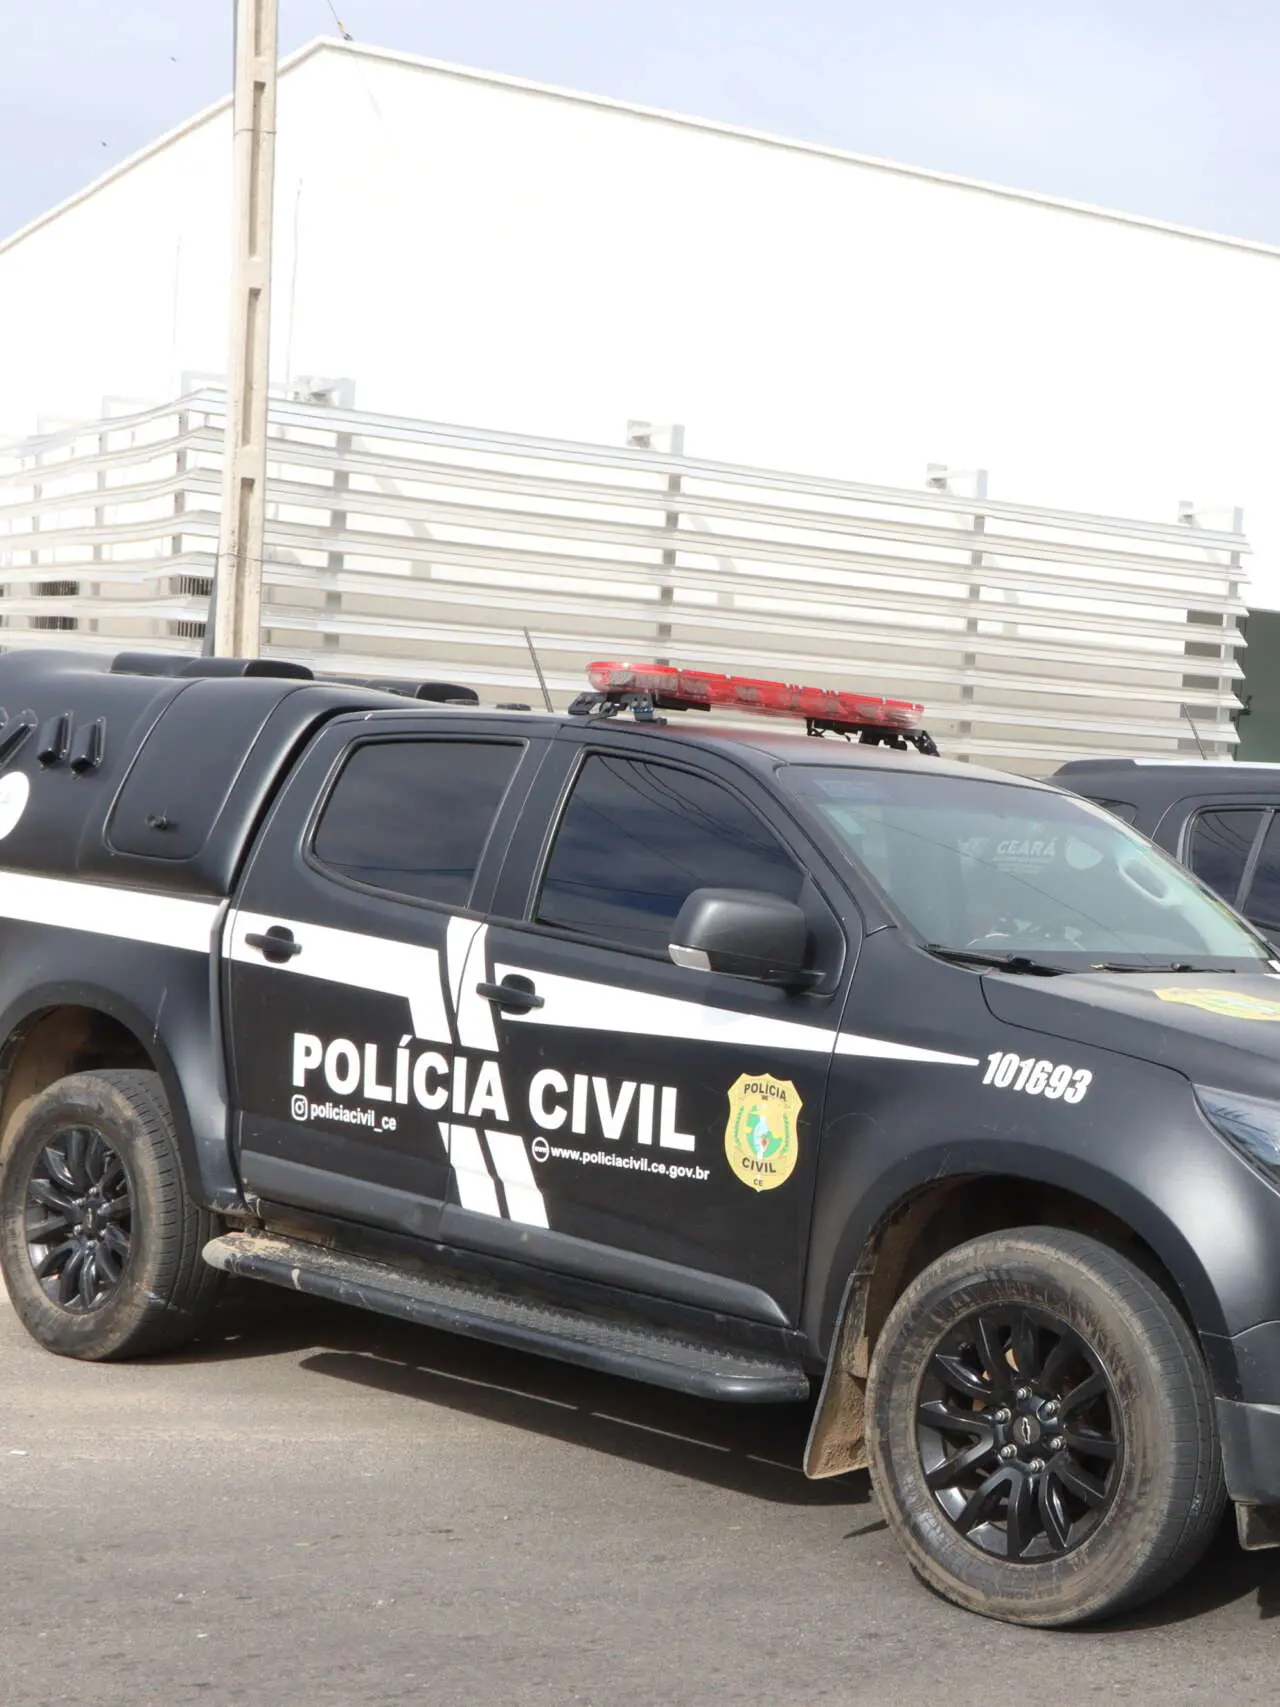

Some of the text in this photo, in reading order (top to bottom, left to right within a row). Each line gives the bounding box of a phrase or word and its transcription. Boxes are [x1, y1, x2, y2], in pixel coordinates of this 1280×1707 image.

[292, 1032, 696, 1152] POLÍCIA CIVIL
[744, 1082, 787, 1102] POLÍCIA
[982, 1051, 1093, 1104] 101693
[310, 1101, 397, 1133] policiacivil_ce
[551, 1146, 710, 1180] www.policiacivil.ce.gov.br
[742, 1157, 777, 1173] CIVIL
[753, 1178, 763, 1186] CE
